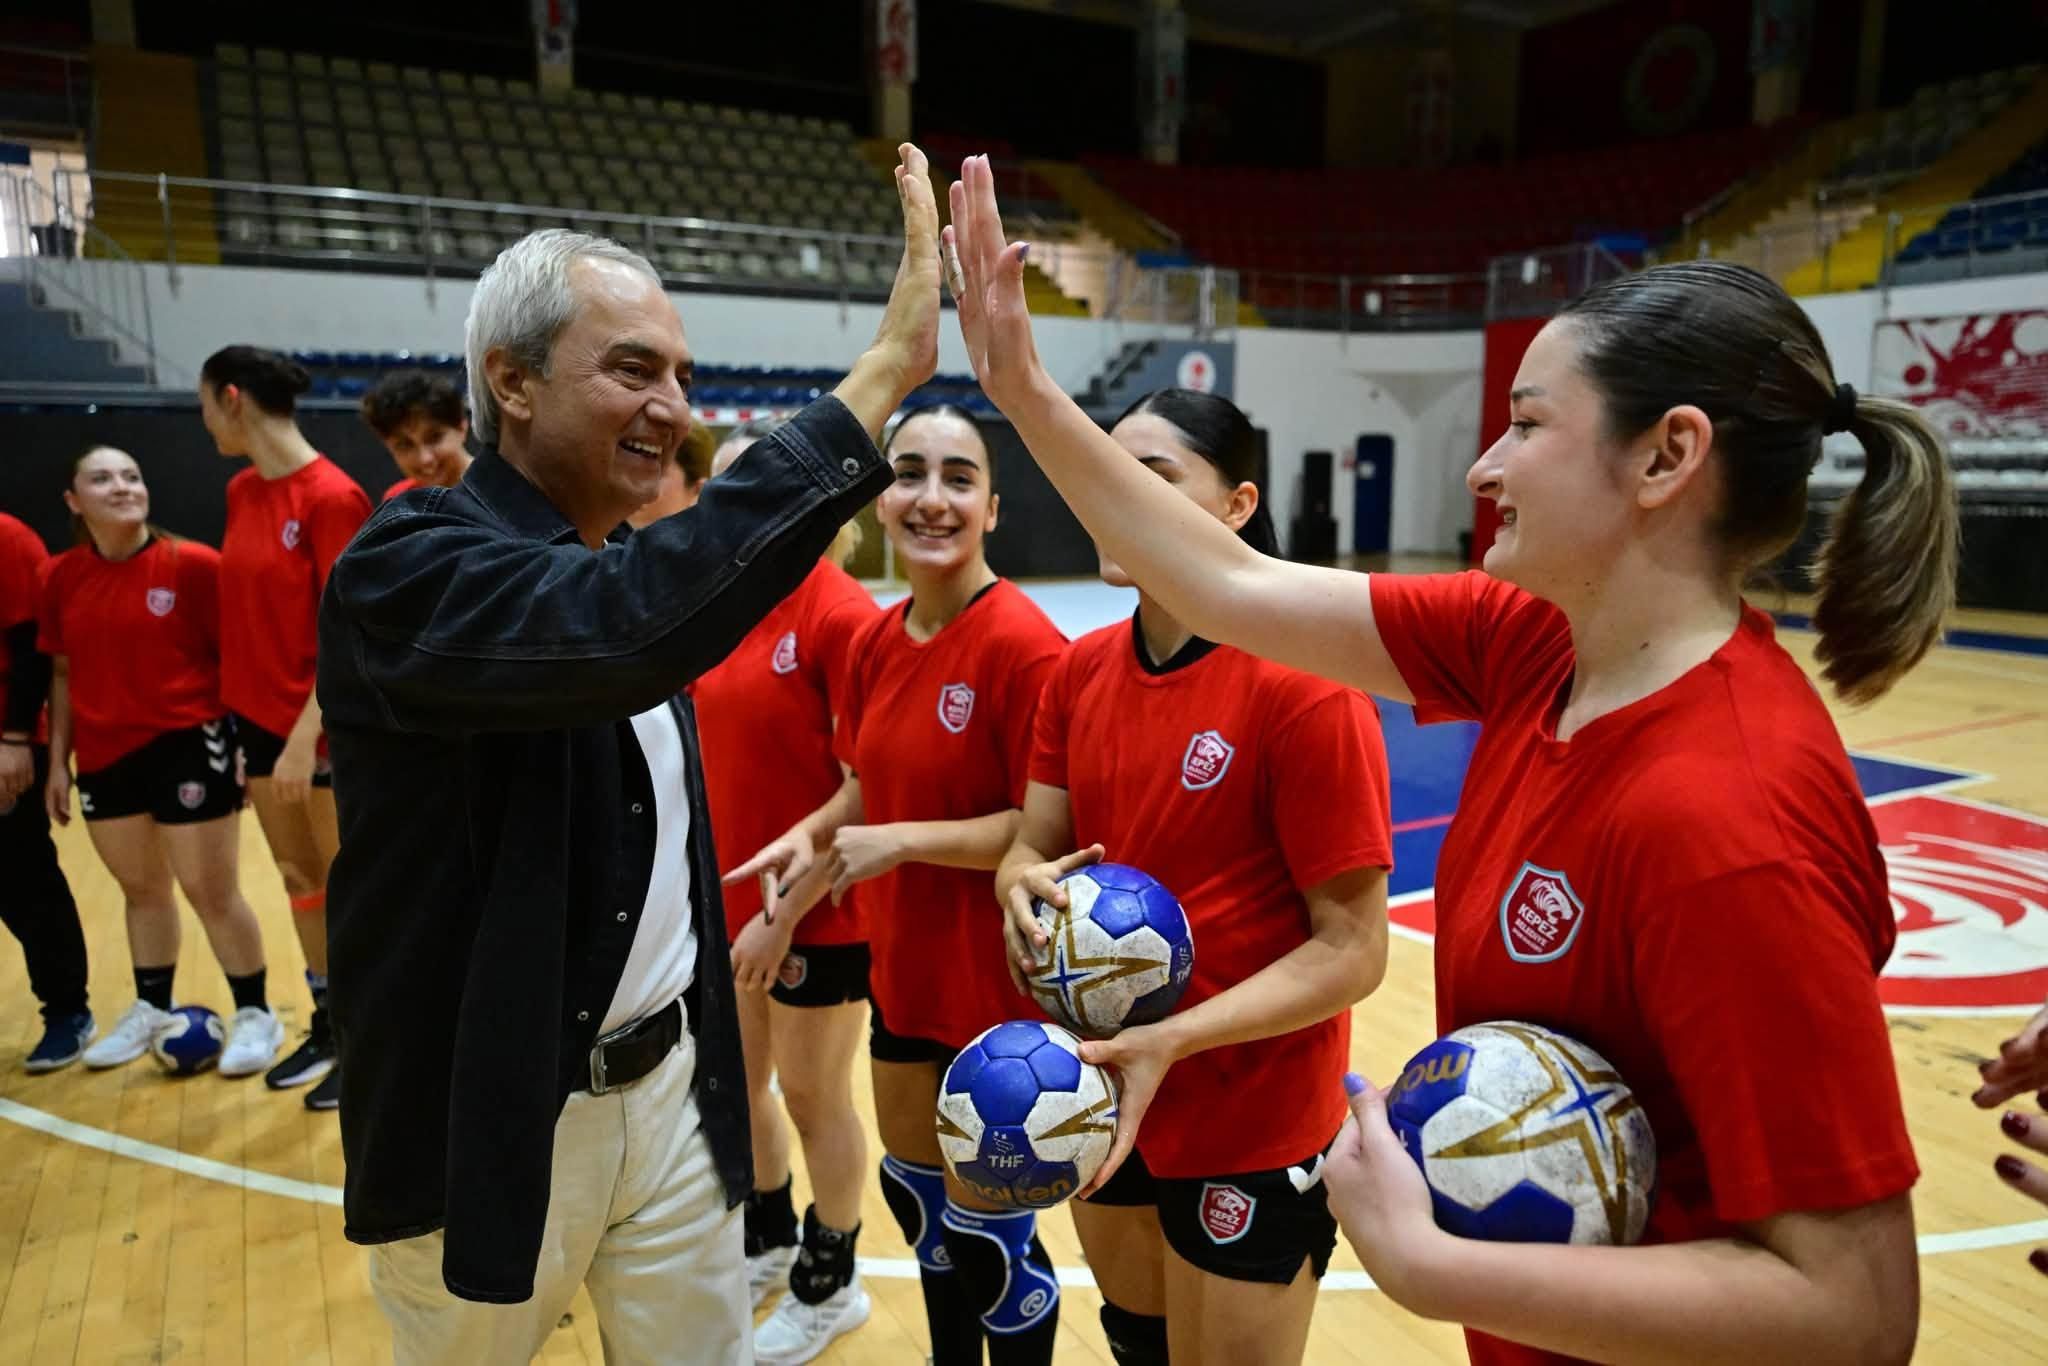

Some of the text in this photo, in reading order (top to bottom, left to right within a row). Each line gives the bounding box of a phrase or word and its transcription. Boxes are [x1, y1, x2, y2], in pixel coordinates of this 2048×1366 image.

[1518, 903, 1558, 940] KEPEZ
[988, 1154, 1025, 1168] THF
[1209, 1208, 1240, 1226] KEPEZ
